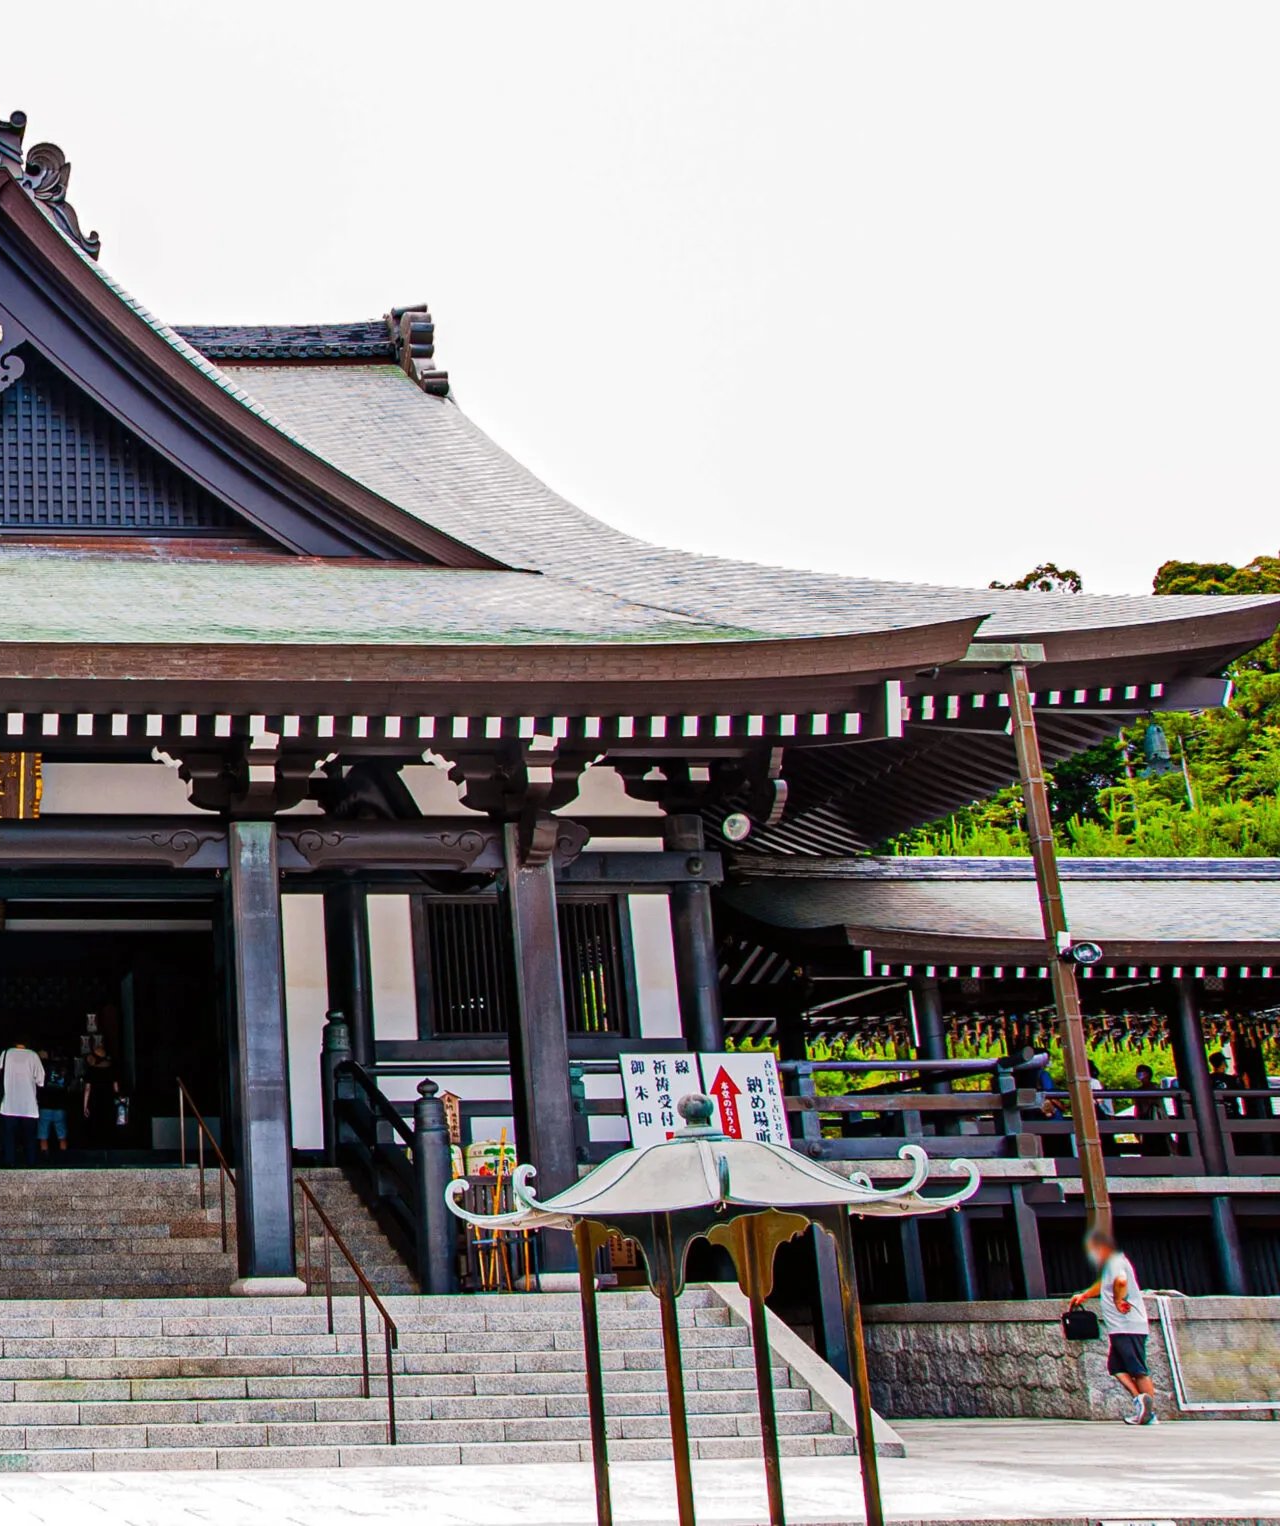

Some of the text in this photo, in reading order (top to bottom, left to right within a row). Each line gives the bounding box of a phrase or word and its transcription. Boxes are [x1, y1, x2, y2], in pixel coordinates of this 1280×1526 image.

[630, 1059, 652, 1126] 御朱印
[652, 1059, 674, 1127] 祈祷受付
[746, 1076, 772, 1143] 納め場所
